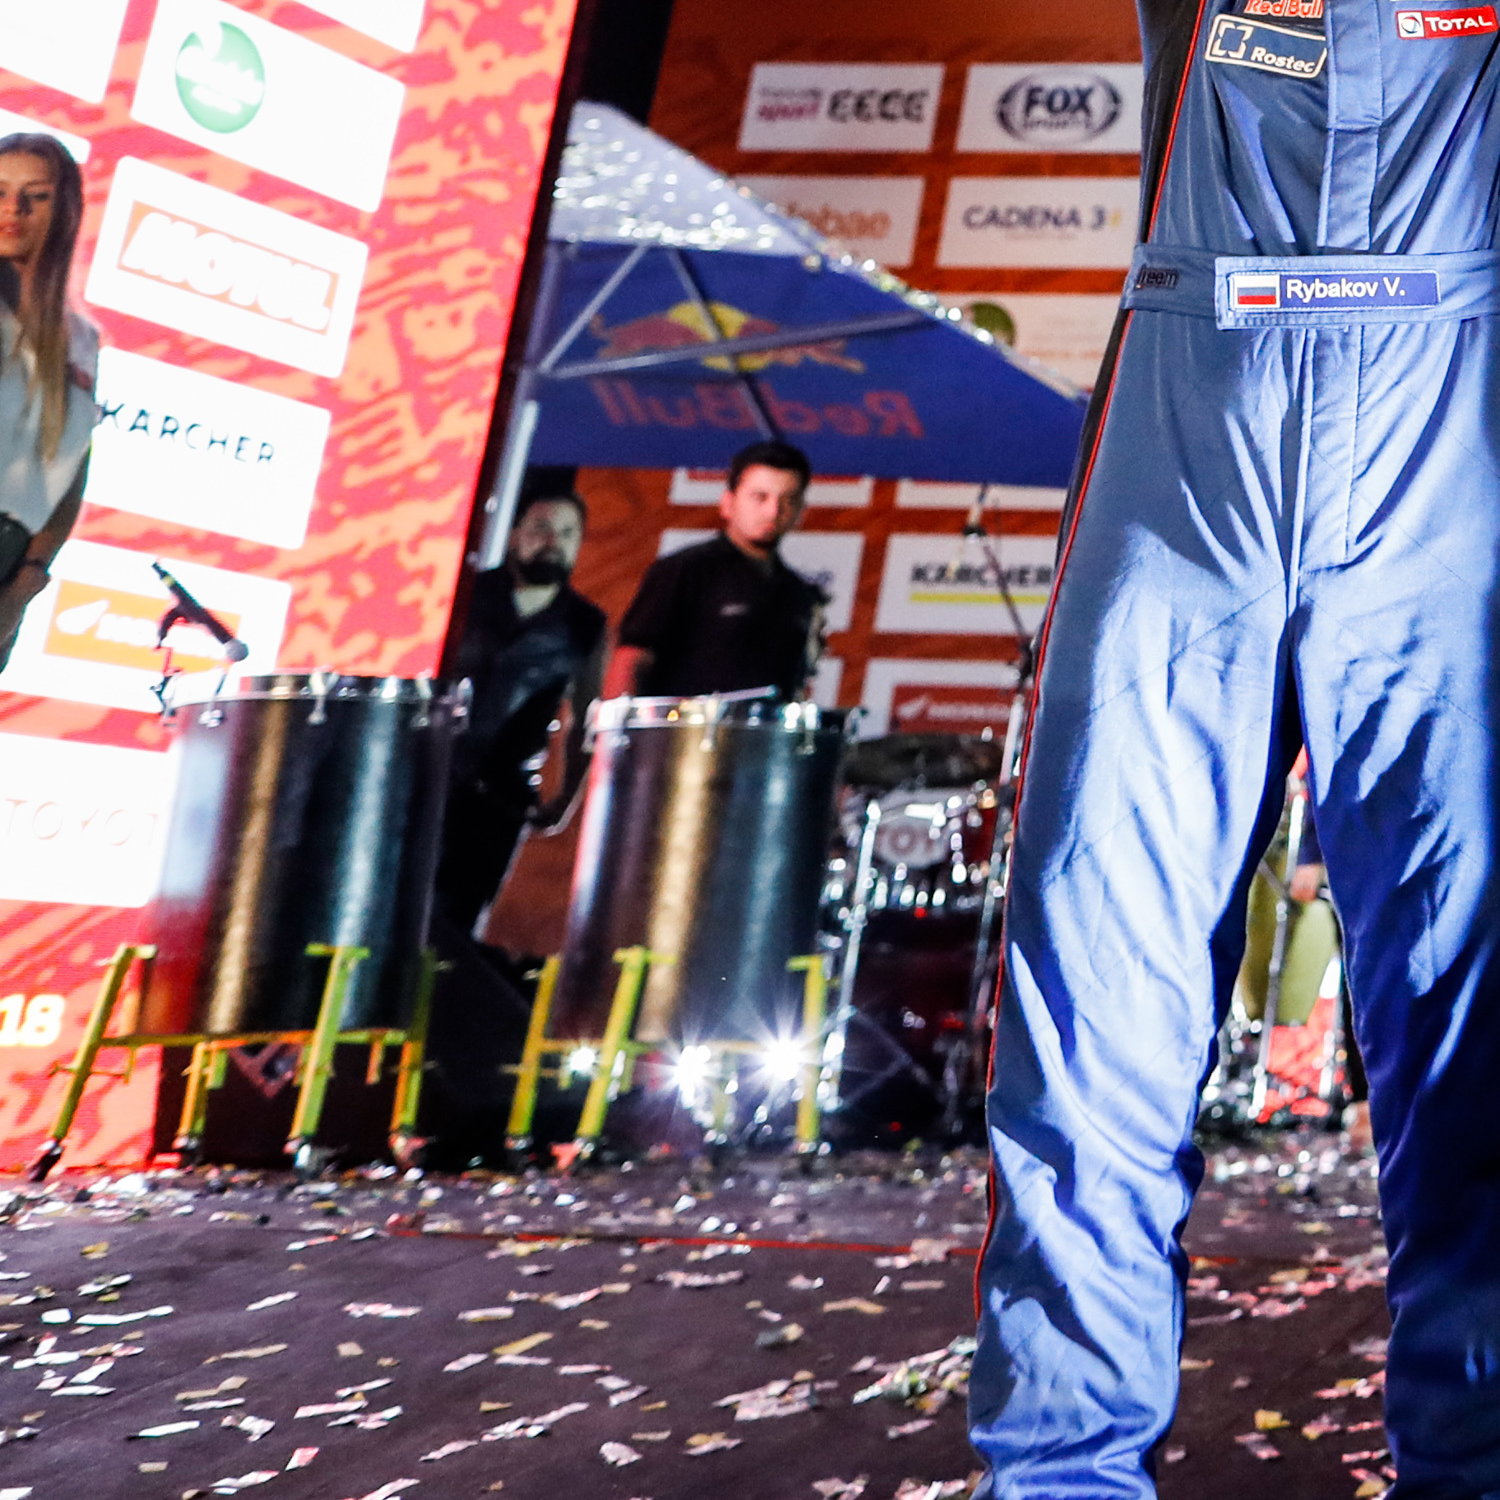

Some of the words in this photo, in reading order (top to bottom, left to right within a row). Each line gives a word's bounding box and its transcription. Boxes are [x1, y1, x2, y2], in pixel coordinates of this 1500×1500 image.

[1250, 46, 1316, 74] Rostec
[1024, 86, 1094, 119] FOX
[962, 204, 1081, 231] CADENA
[1285, 277, 1379, 304] Rybakov
[1381, 276, 1406, 297] V.
[4, 797, 161, 848] TOYOT
